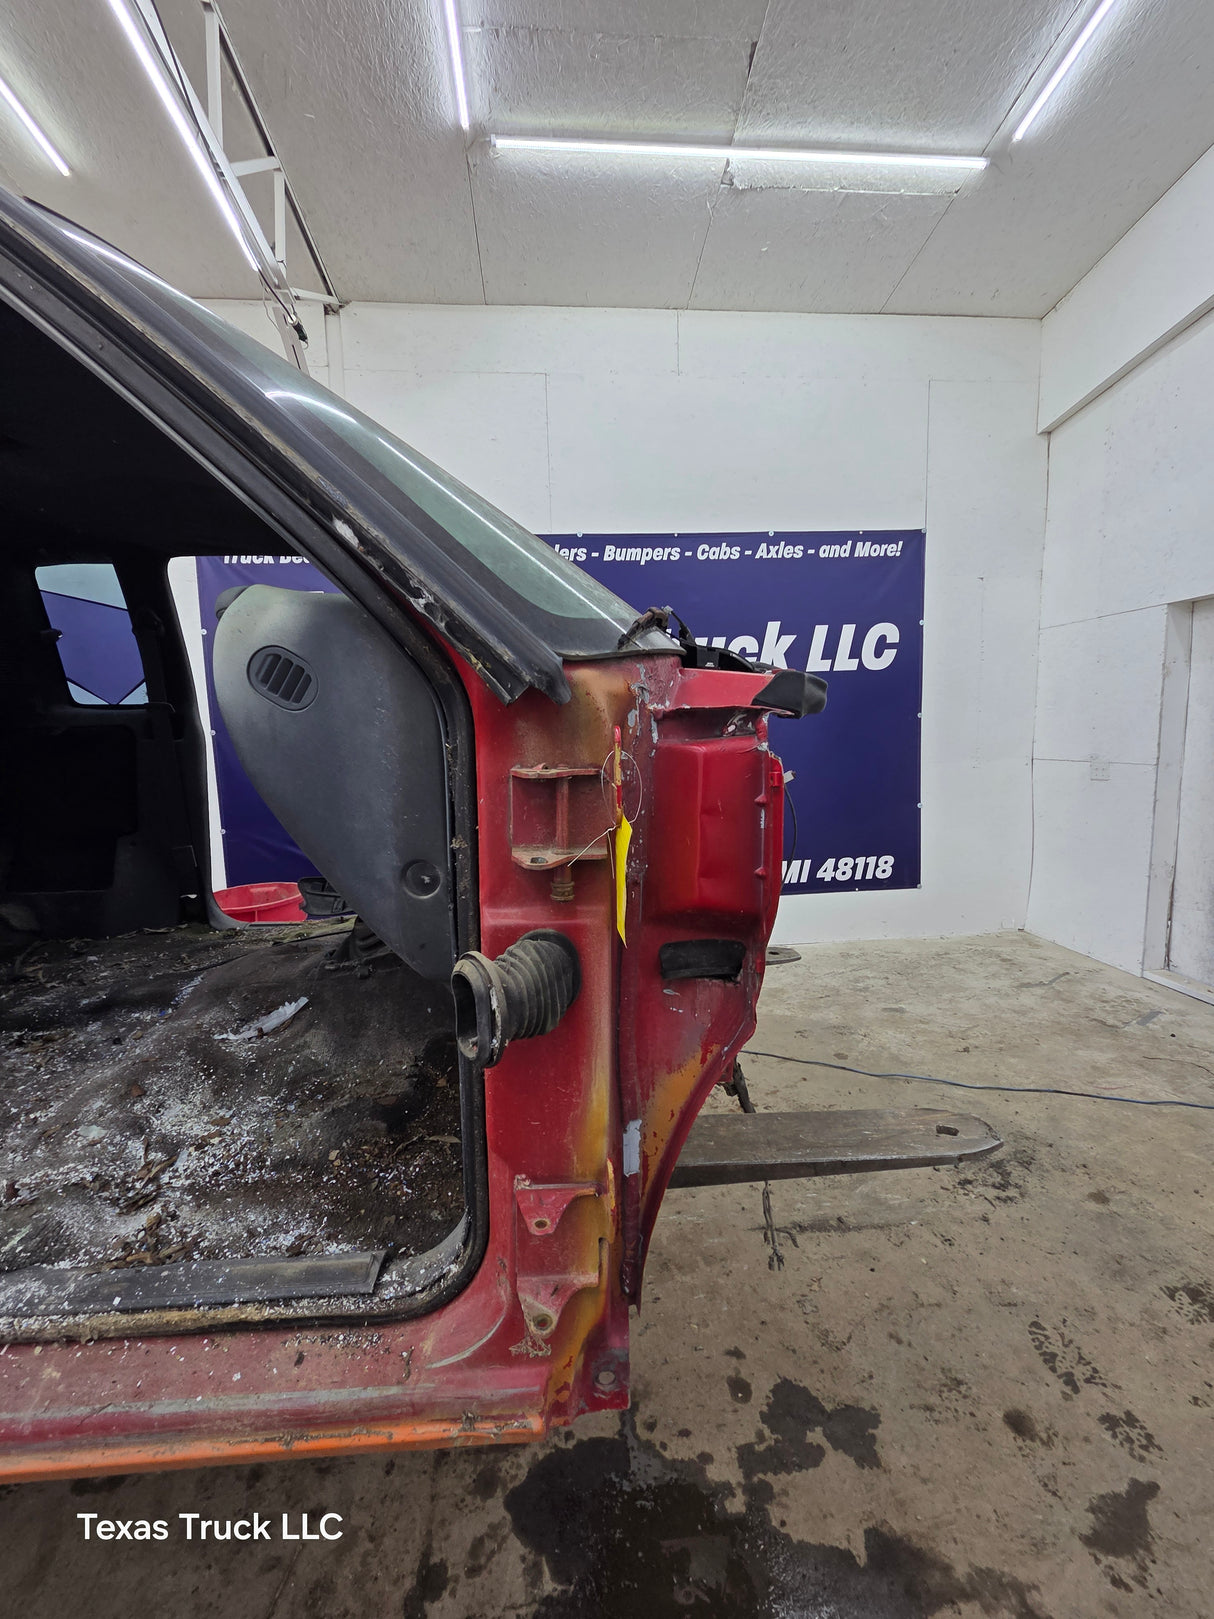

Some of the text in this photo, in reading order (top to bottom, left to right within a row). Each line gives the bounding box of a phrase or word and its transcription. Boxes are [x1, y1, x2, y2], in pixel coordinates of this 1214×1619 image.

[603, 544, 680, 565] Bumpers
[697, 542, 741, 560] Cabs
[755, 542, 804, 559] Axles
[818, 541, 853, 558] and
[854, 540, 904, 558] More!
[805, 622, 900, 673] LLC
[816, 855, 895, 882] 48118
